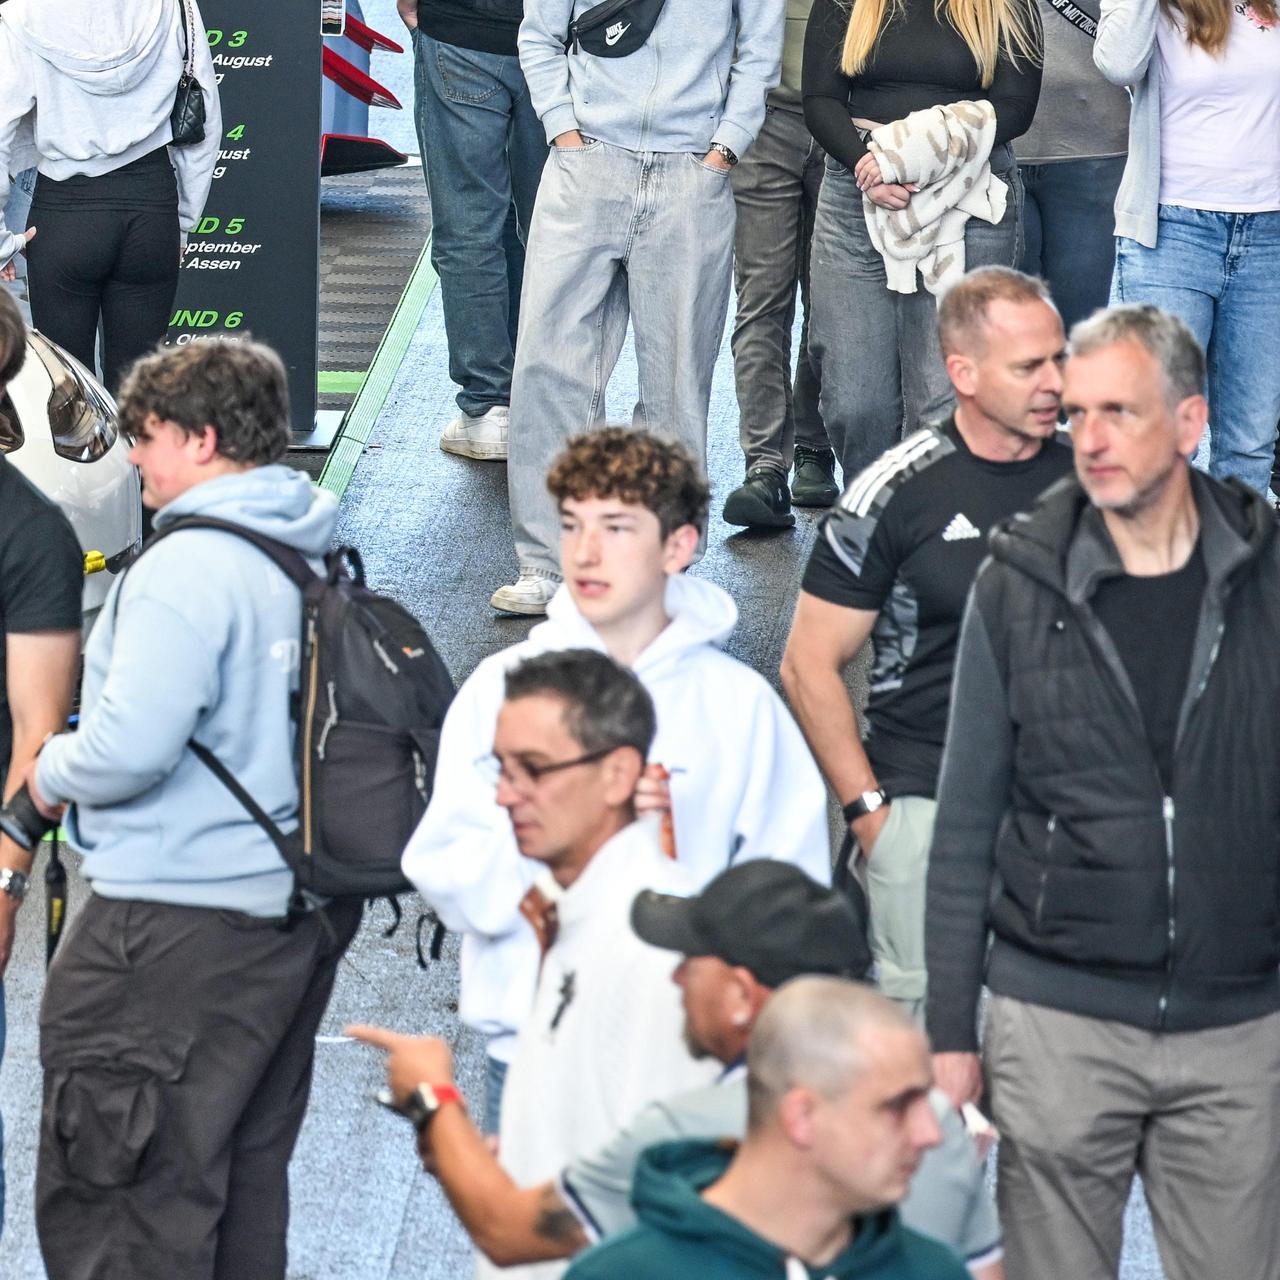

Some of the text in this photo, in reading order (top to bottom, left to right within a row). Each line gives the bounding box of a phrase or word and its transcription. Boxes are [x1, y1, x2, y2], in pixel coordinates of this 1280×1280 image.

[606, 21, 623, 38] NIKE
[228, 30, 248, 47] 3
[211, 54, 273, 68] August
[226, 125, 245, 141] 4
[215, 149, 250, 162] gust
[225, 219, 245, 235] 5
[184, 241, 261, 255] ptember
[186, 257, 241, 270] Assen
[168, 310, 244, 328] UND 6
